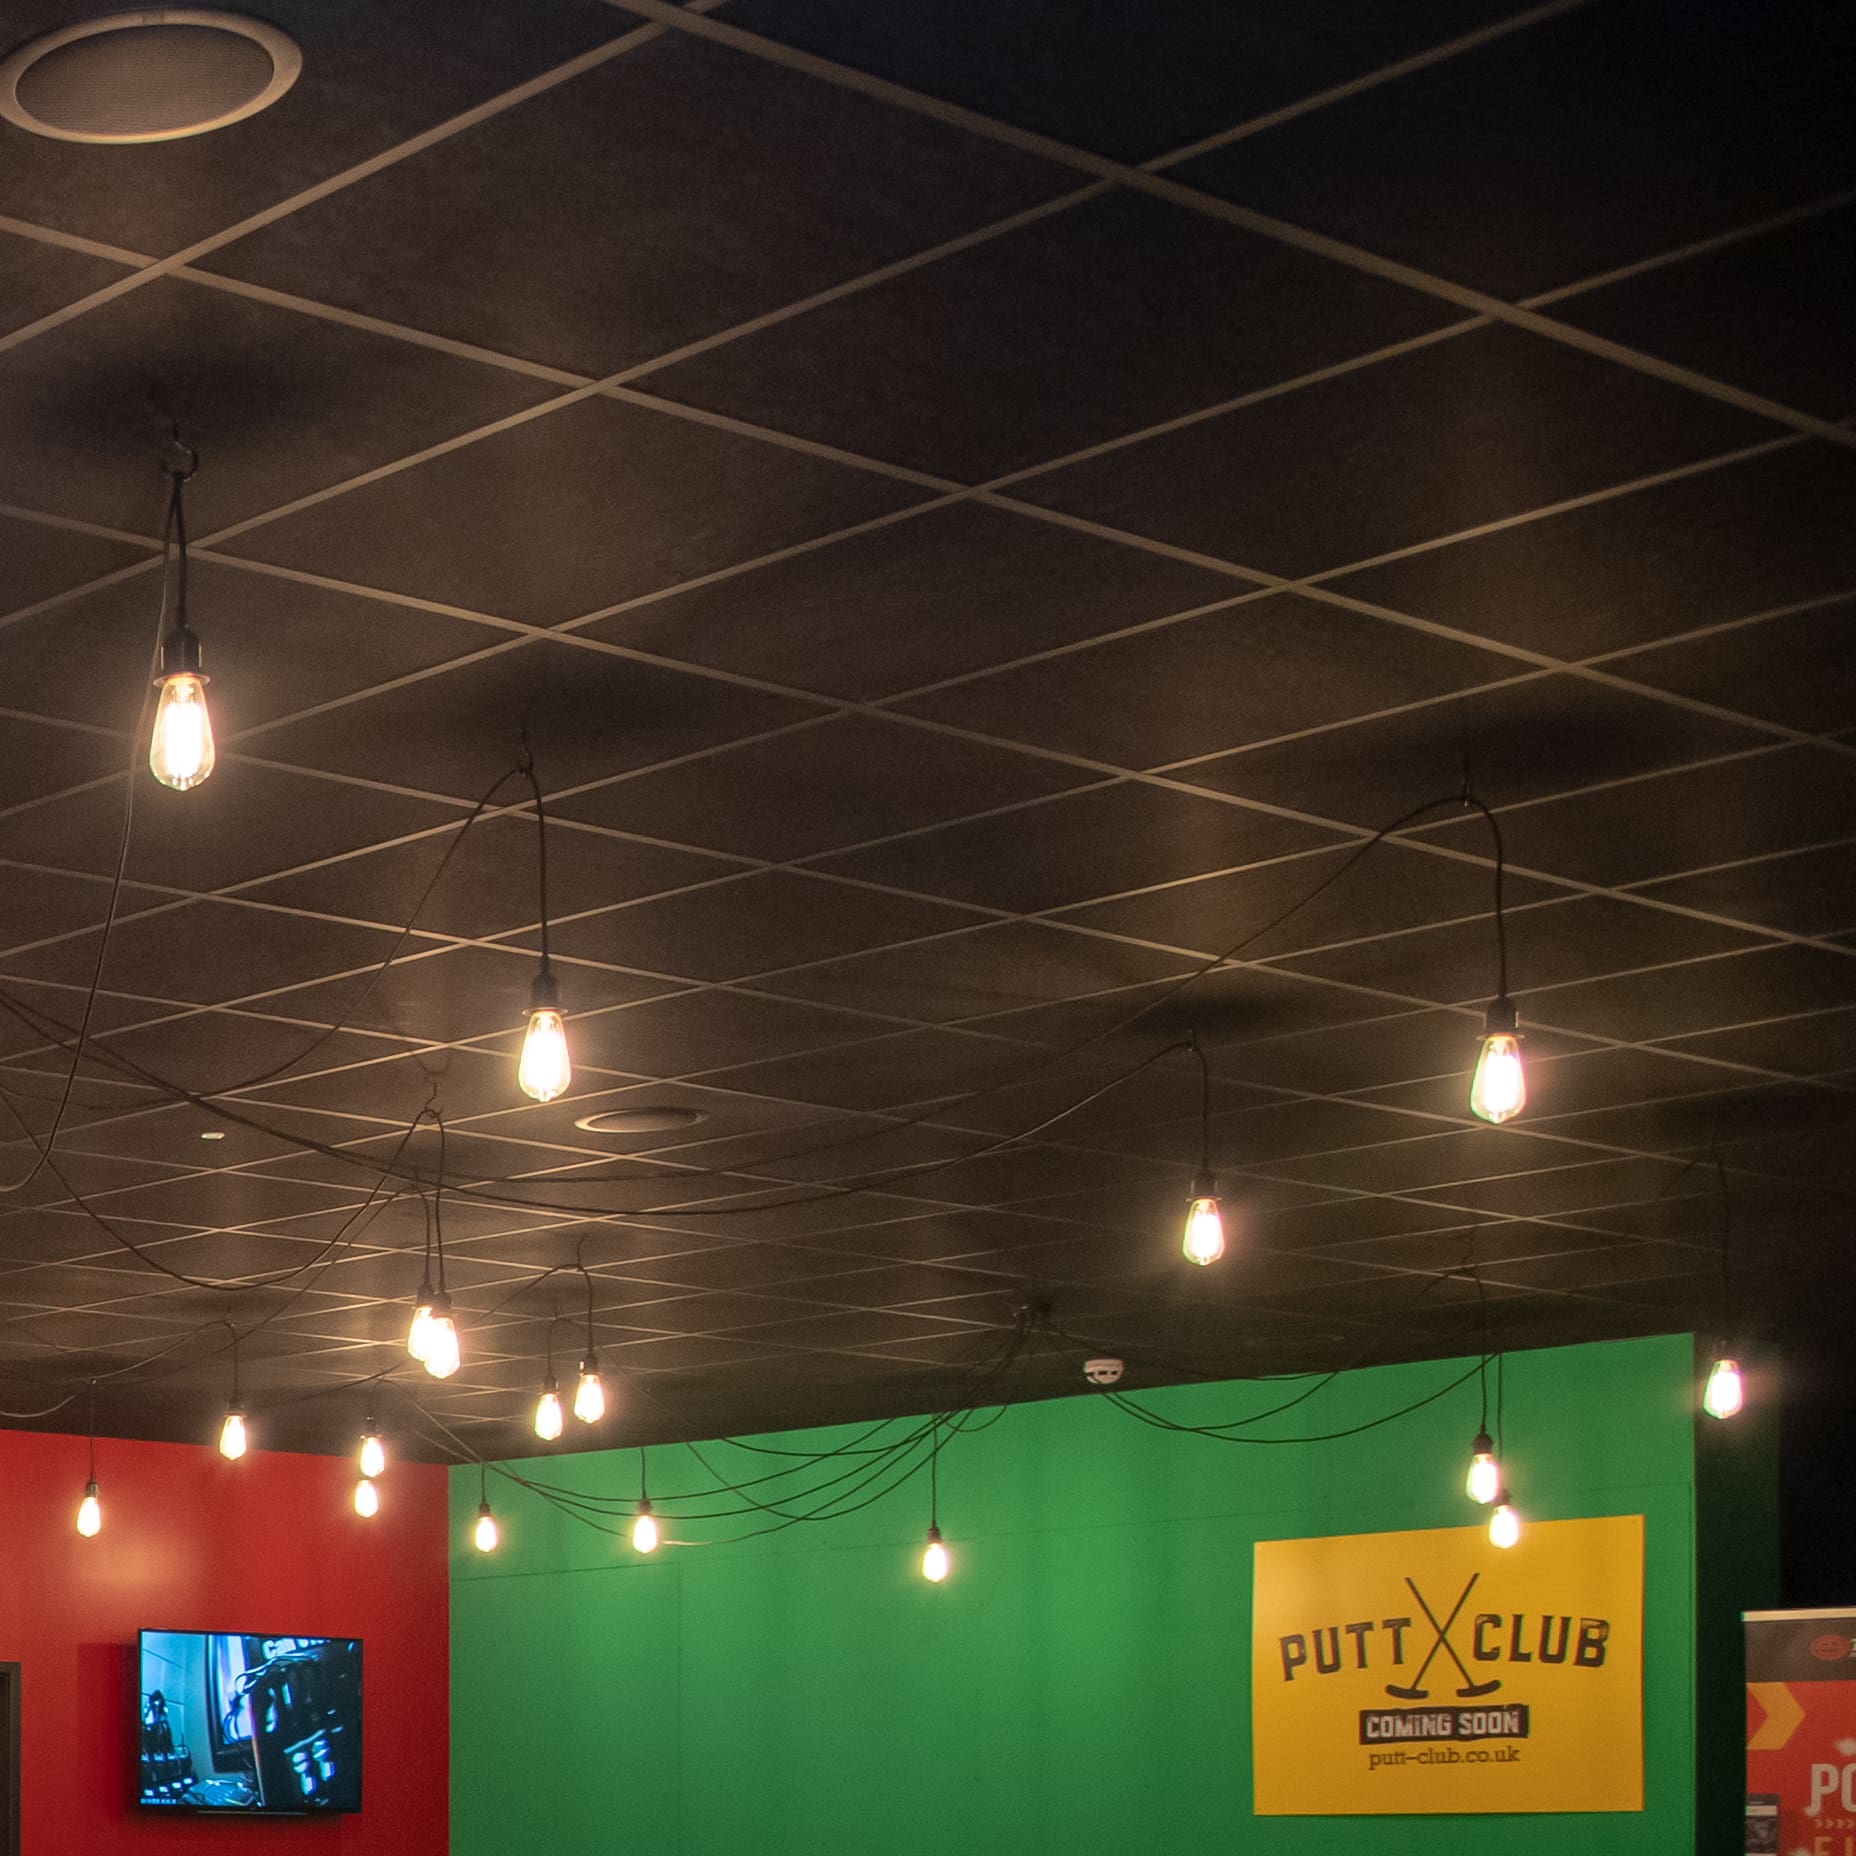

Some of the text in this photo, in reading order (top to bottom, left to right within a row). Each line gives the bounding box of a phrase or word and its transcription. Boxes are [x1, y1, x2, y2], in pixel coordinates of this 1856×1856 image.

[1278, 1613, 1610, 1682] PUTT CLUB
[1365, 1709, 1519, 1738] COMING SOON
[1368, 1745, 1520, 1771] putt-club.co.uk
